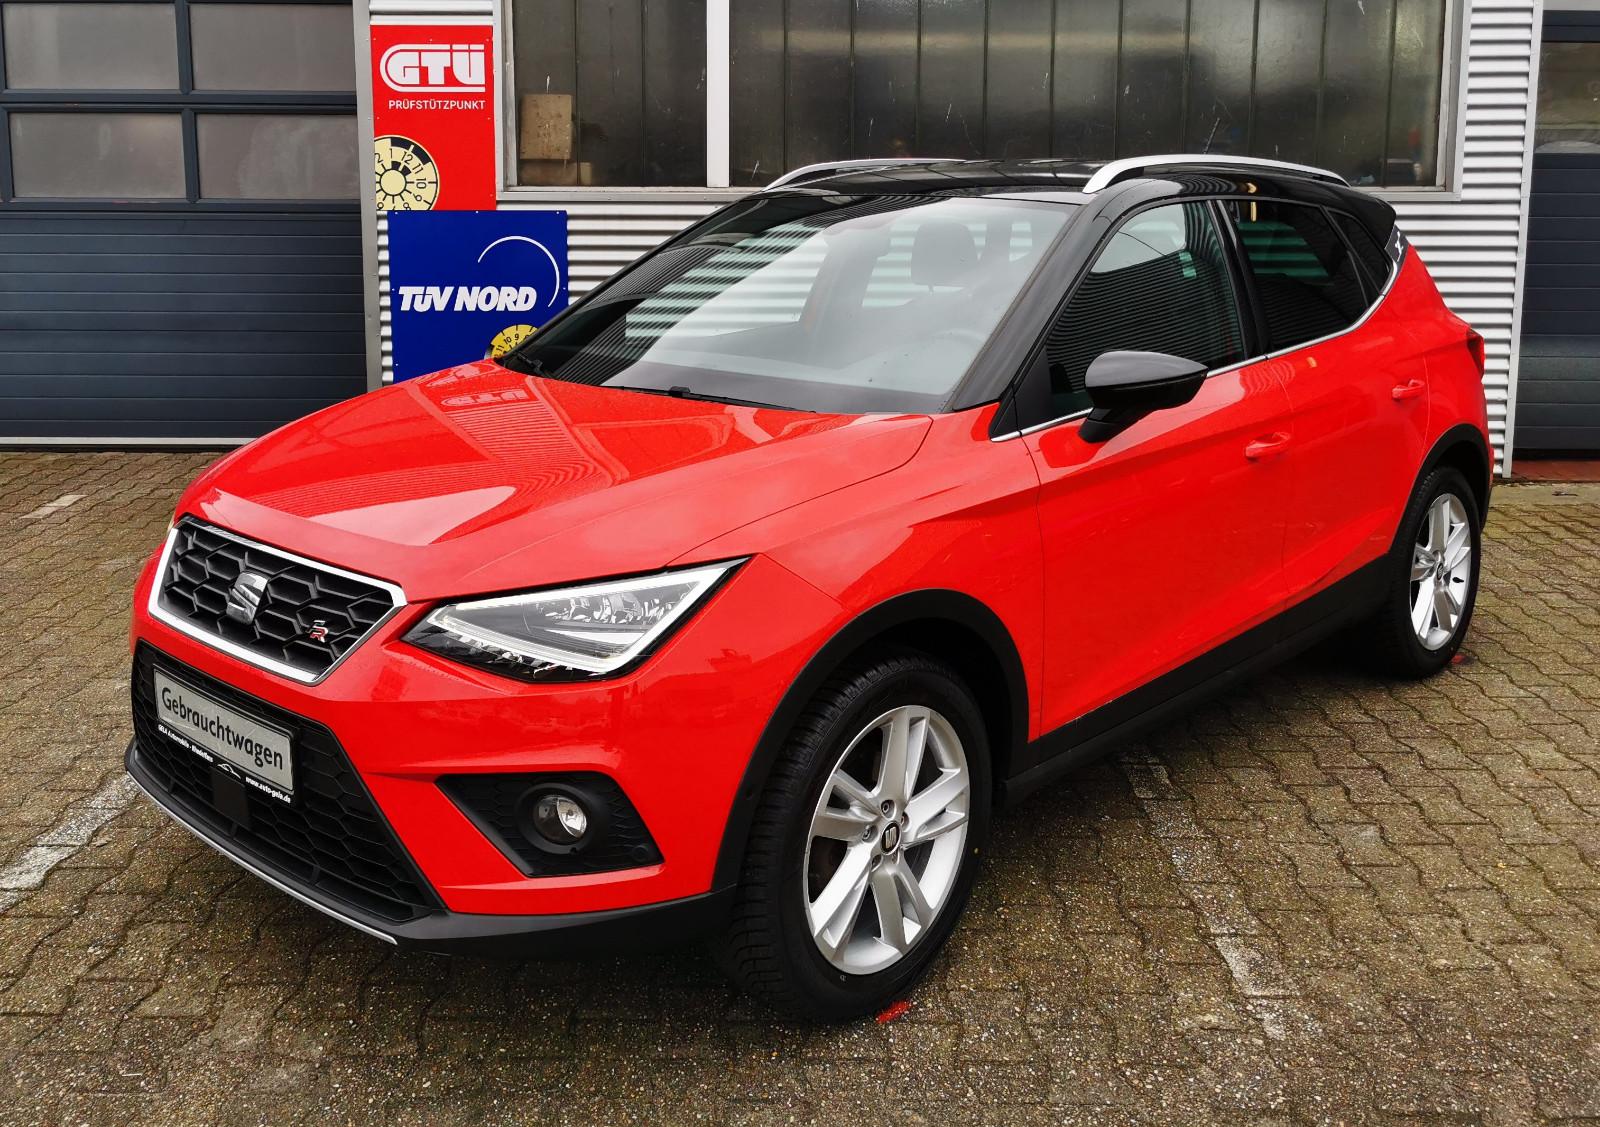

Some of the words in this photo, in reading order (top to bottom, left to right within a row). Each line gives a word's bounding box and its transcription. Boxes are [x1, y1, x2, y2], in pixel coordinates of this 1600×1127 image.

[380, 44, 485, 92] GTÜ
[388, 98, 485, 110] PRÜFSTÜTZPUNKT
[389, 148, 393, 159] 1
[401, 151, 413, 165] 12
[412, 163, 424, 174] 11
[416, 178, 427, 189] 10
[399, 286, 454, 313] TÜV
[454, 286, 537, 312] NORD
[503, 336, 512, 345] 10
[161, 687, 283, 770] Gebrauchtwagen
